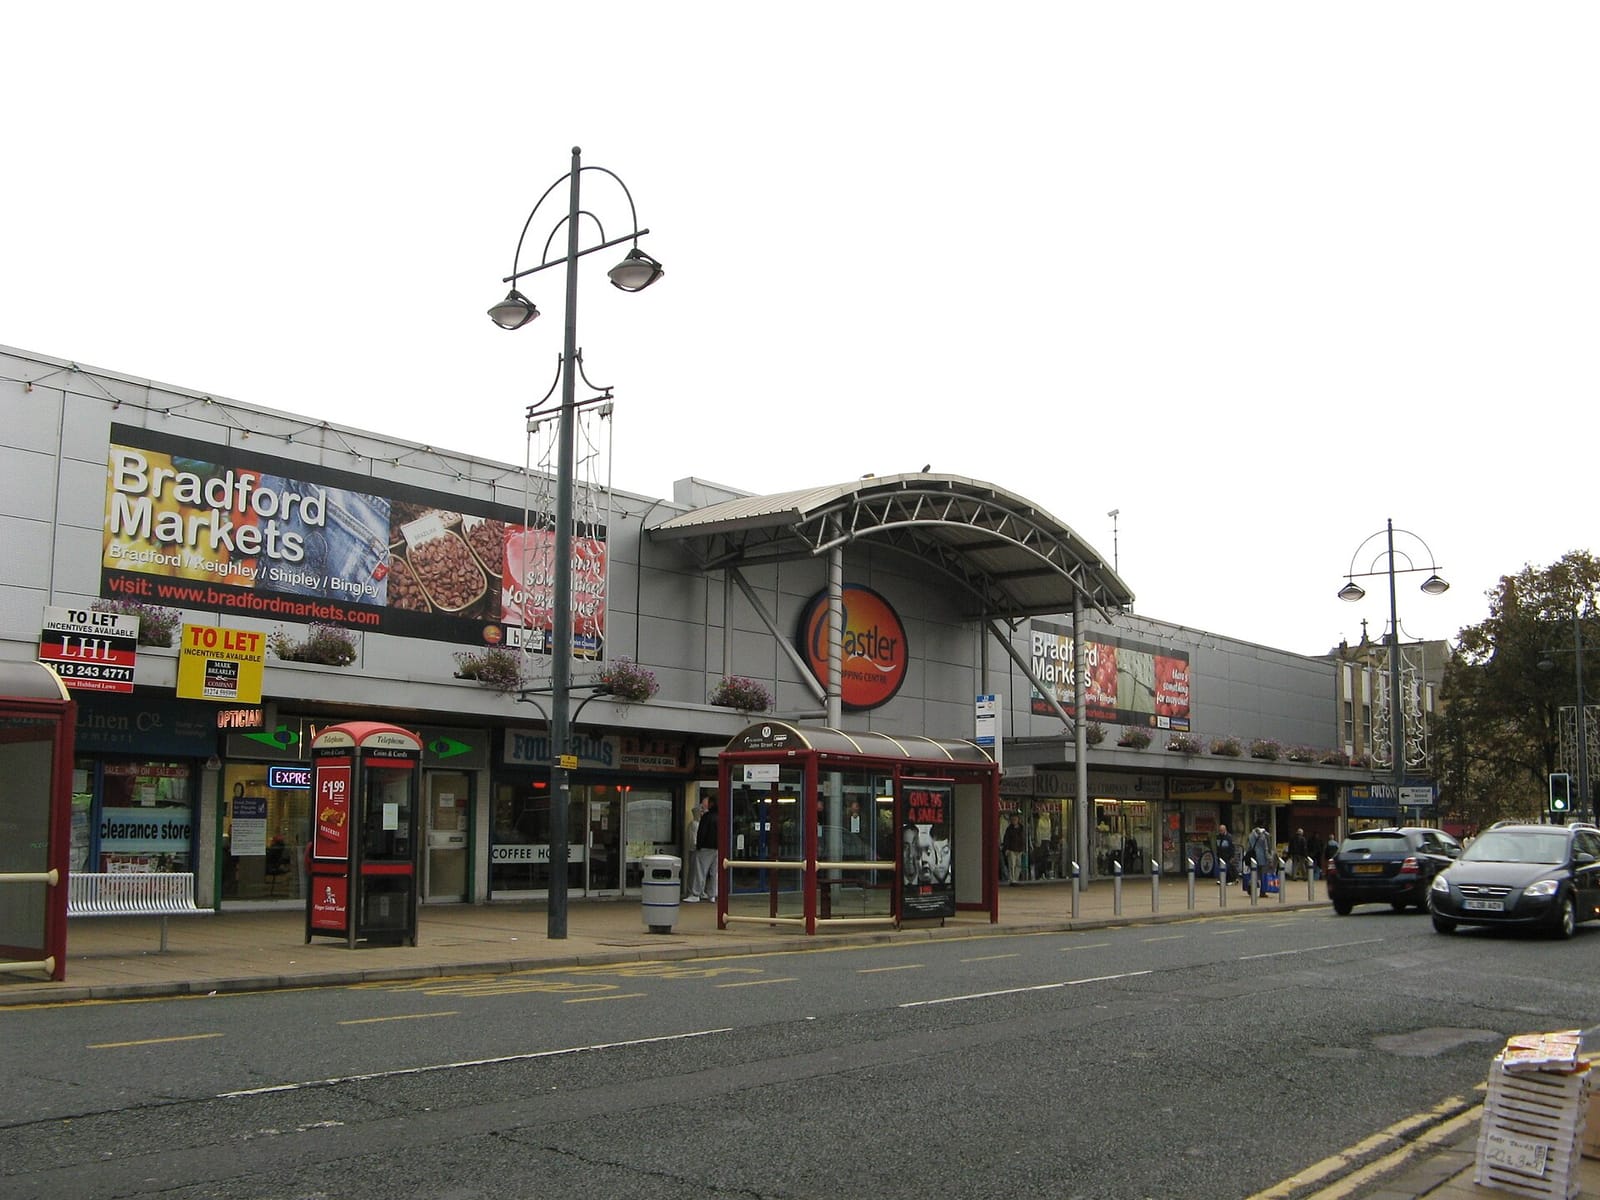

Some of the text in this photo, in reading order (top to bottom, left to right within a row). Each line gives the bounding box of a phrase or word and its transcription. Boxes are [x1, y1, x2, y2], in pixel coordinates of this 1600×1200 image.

[112, 451, 326, 527] Bradford
[110, 492, 304, 562] Markets
[109, 544, 181, 567] Bradford
[194, 556, 258, 581] Keighley
[269, 567, 320, 589] Shipley
[331, 577, 379, 598] Bingley
[109, 576, 380, 625] visit: www.bradfordmarkets.com
[68, 610, 118, 627] TO LET
[47, 621, 134, 637] INCENTIVES AVAILABLE
[60, 635, 117, 661] LHL
[190, 627, 260, 652] TO LET
[184, 648, 261, 663] INCENTIVES AVAILABLE
[1032, 636, 1098, 667] Bradfrd
[48, 663, 130, 679] 113 243 4771
[208, 668, 236, 676] BREARLEY
[1032, 656, 1092, 687] Markes
[207, 681, 234, 689] COMPANY
[217, 709, 263, 728] OPTICIAN
[323, 735, 344, 744] Telephone
[376, 735, 405, 745] Telephone
[393, 750, 408, 758] Cards
[513, 733, 613, 767] Fouains
[1036, 774, 1059, 794] RIO
[909, 791, 929, 807] GIVE
[917, 809, 944, 824] SMILE
[101, 818, 190, 839] clearance store
[492, 848, 571, 859] COFFEE HOE
